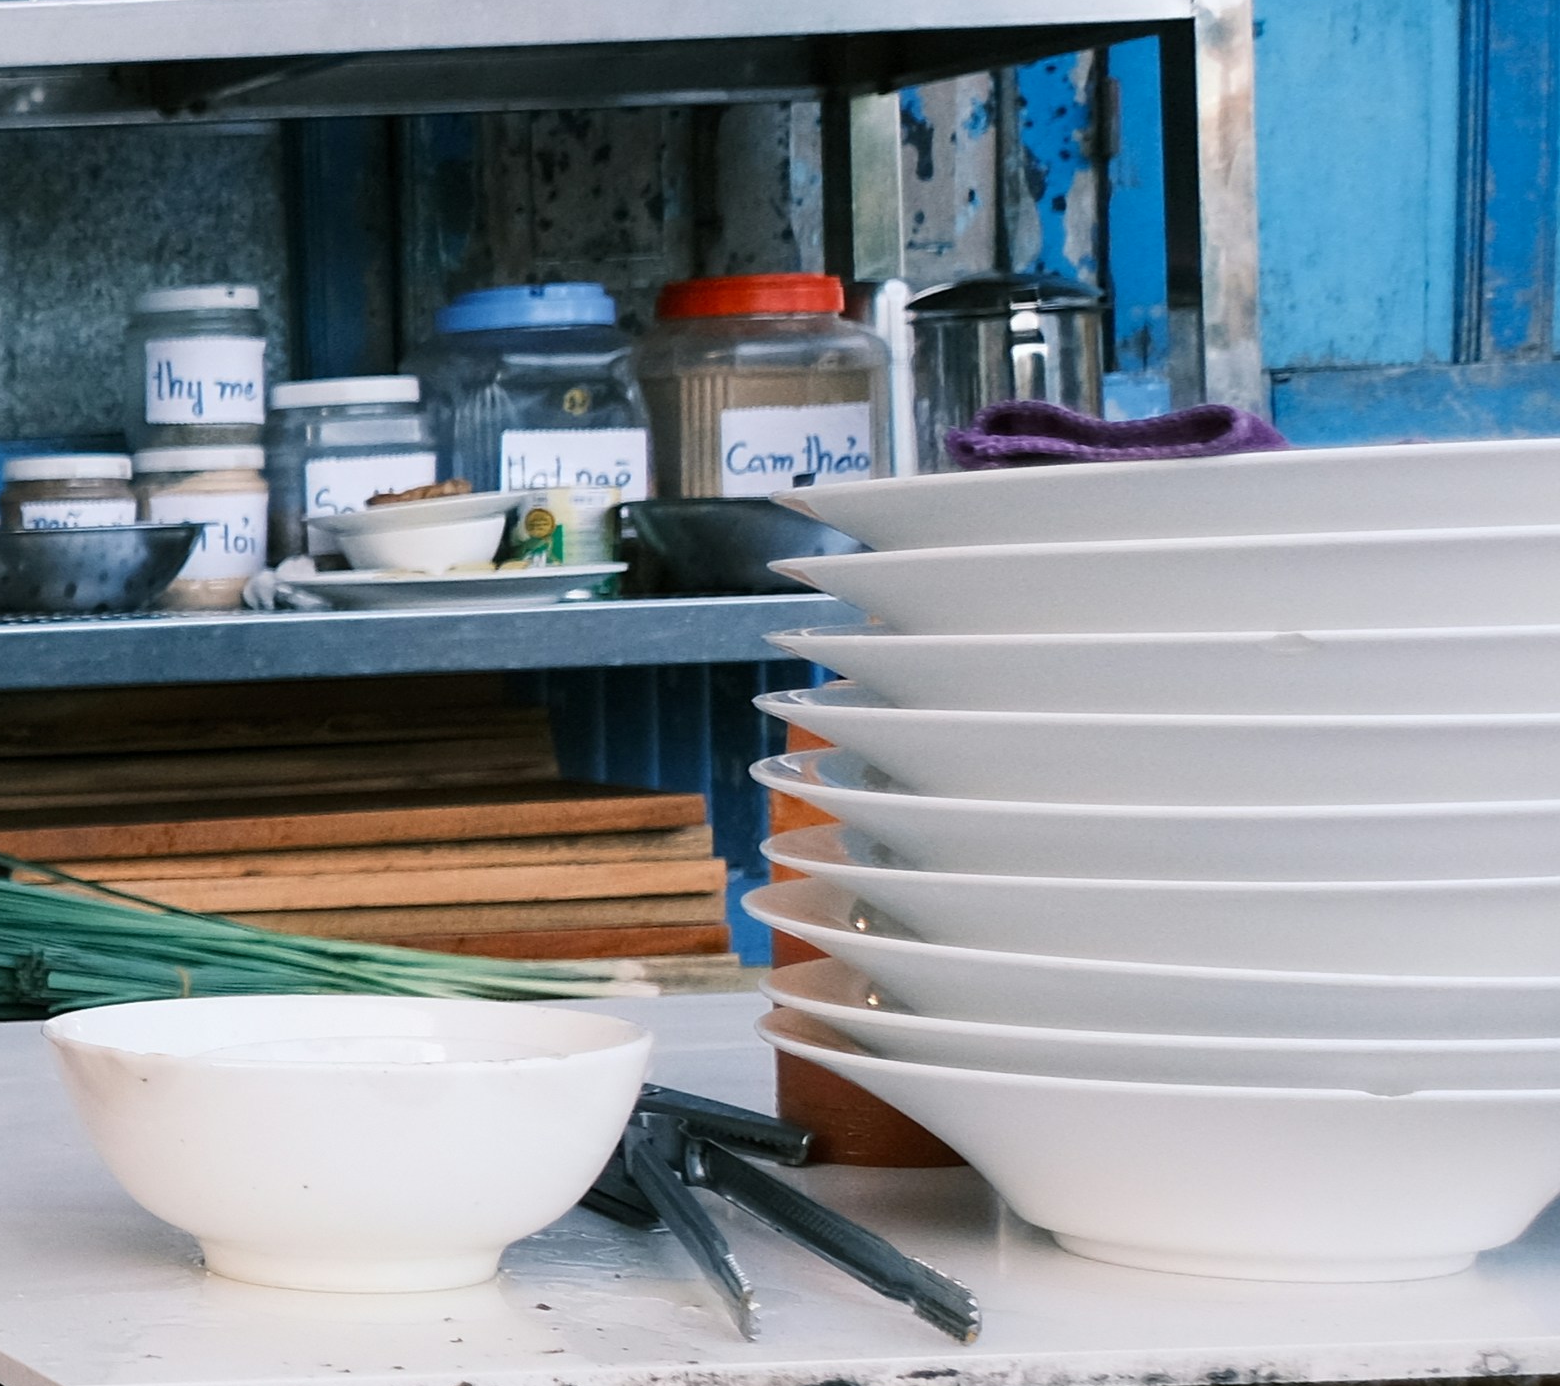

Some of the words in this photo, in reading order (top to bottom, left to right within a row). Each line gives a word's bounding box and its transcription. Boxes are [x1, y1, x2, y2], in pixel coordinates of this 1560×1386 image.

[153, 361, 203, 417] thy
[214, 378, 257, 400] me
[725, 441, 794, 475] Cam
[802, 432, 871, 475] thảo
